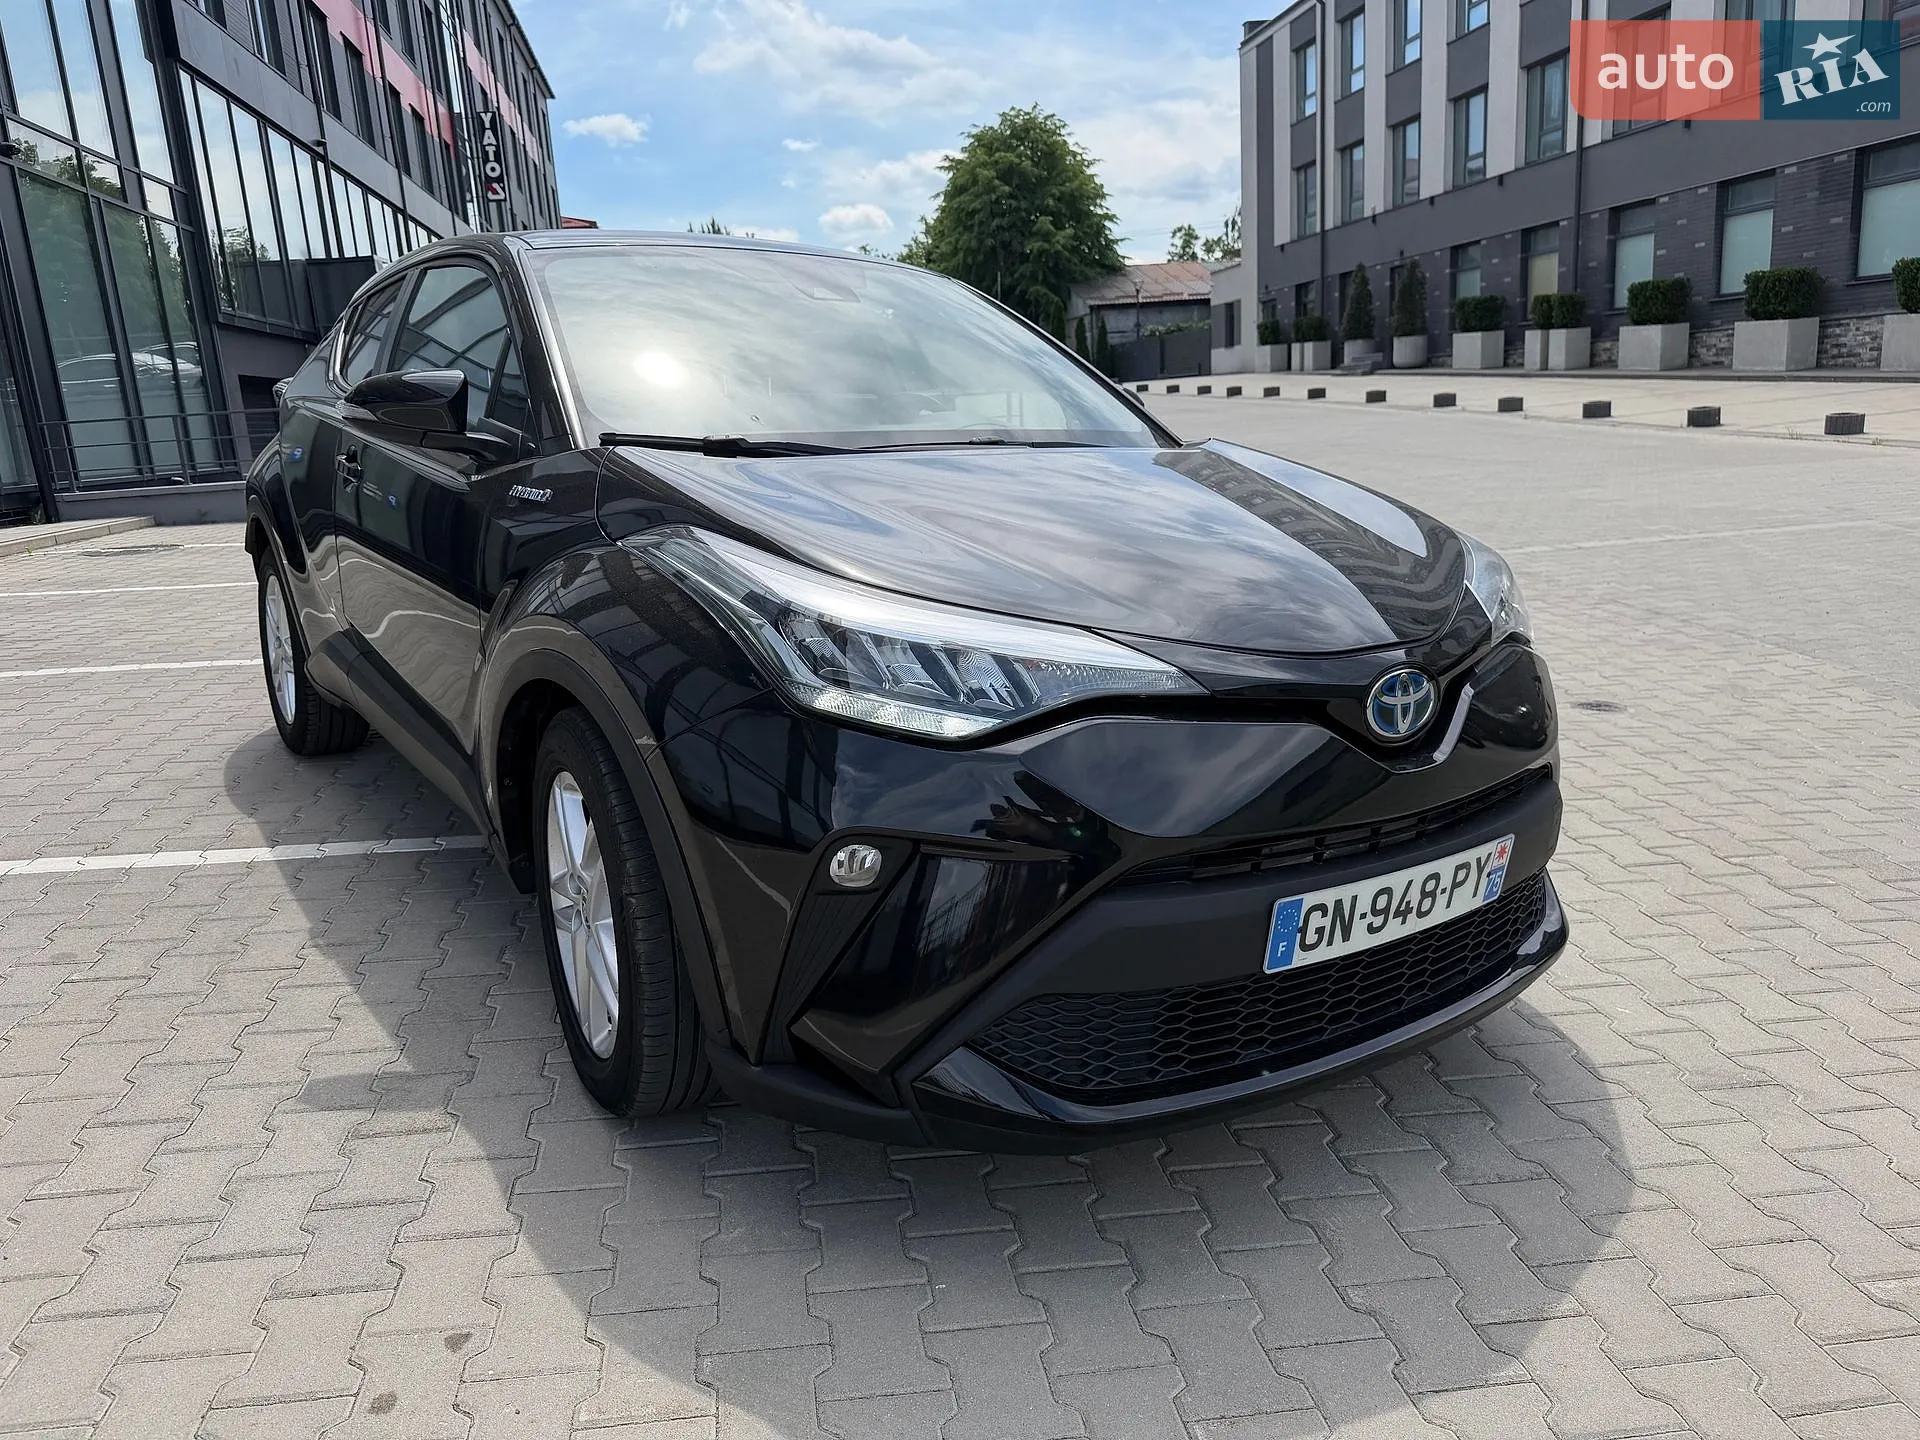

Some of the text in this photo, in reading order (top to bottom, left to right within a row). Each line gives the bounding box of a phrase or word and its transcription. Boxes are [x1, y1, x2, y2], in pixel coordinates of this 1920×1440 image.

[479, 112, 502, 178] YATO
[1298, 851, 1493, 953] GN-948-PY
[1485, 870, 1502, 899] 75
[1277, 941, 1288, 958] F
